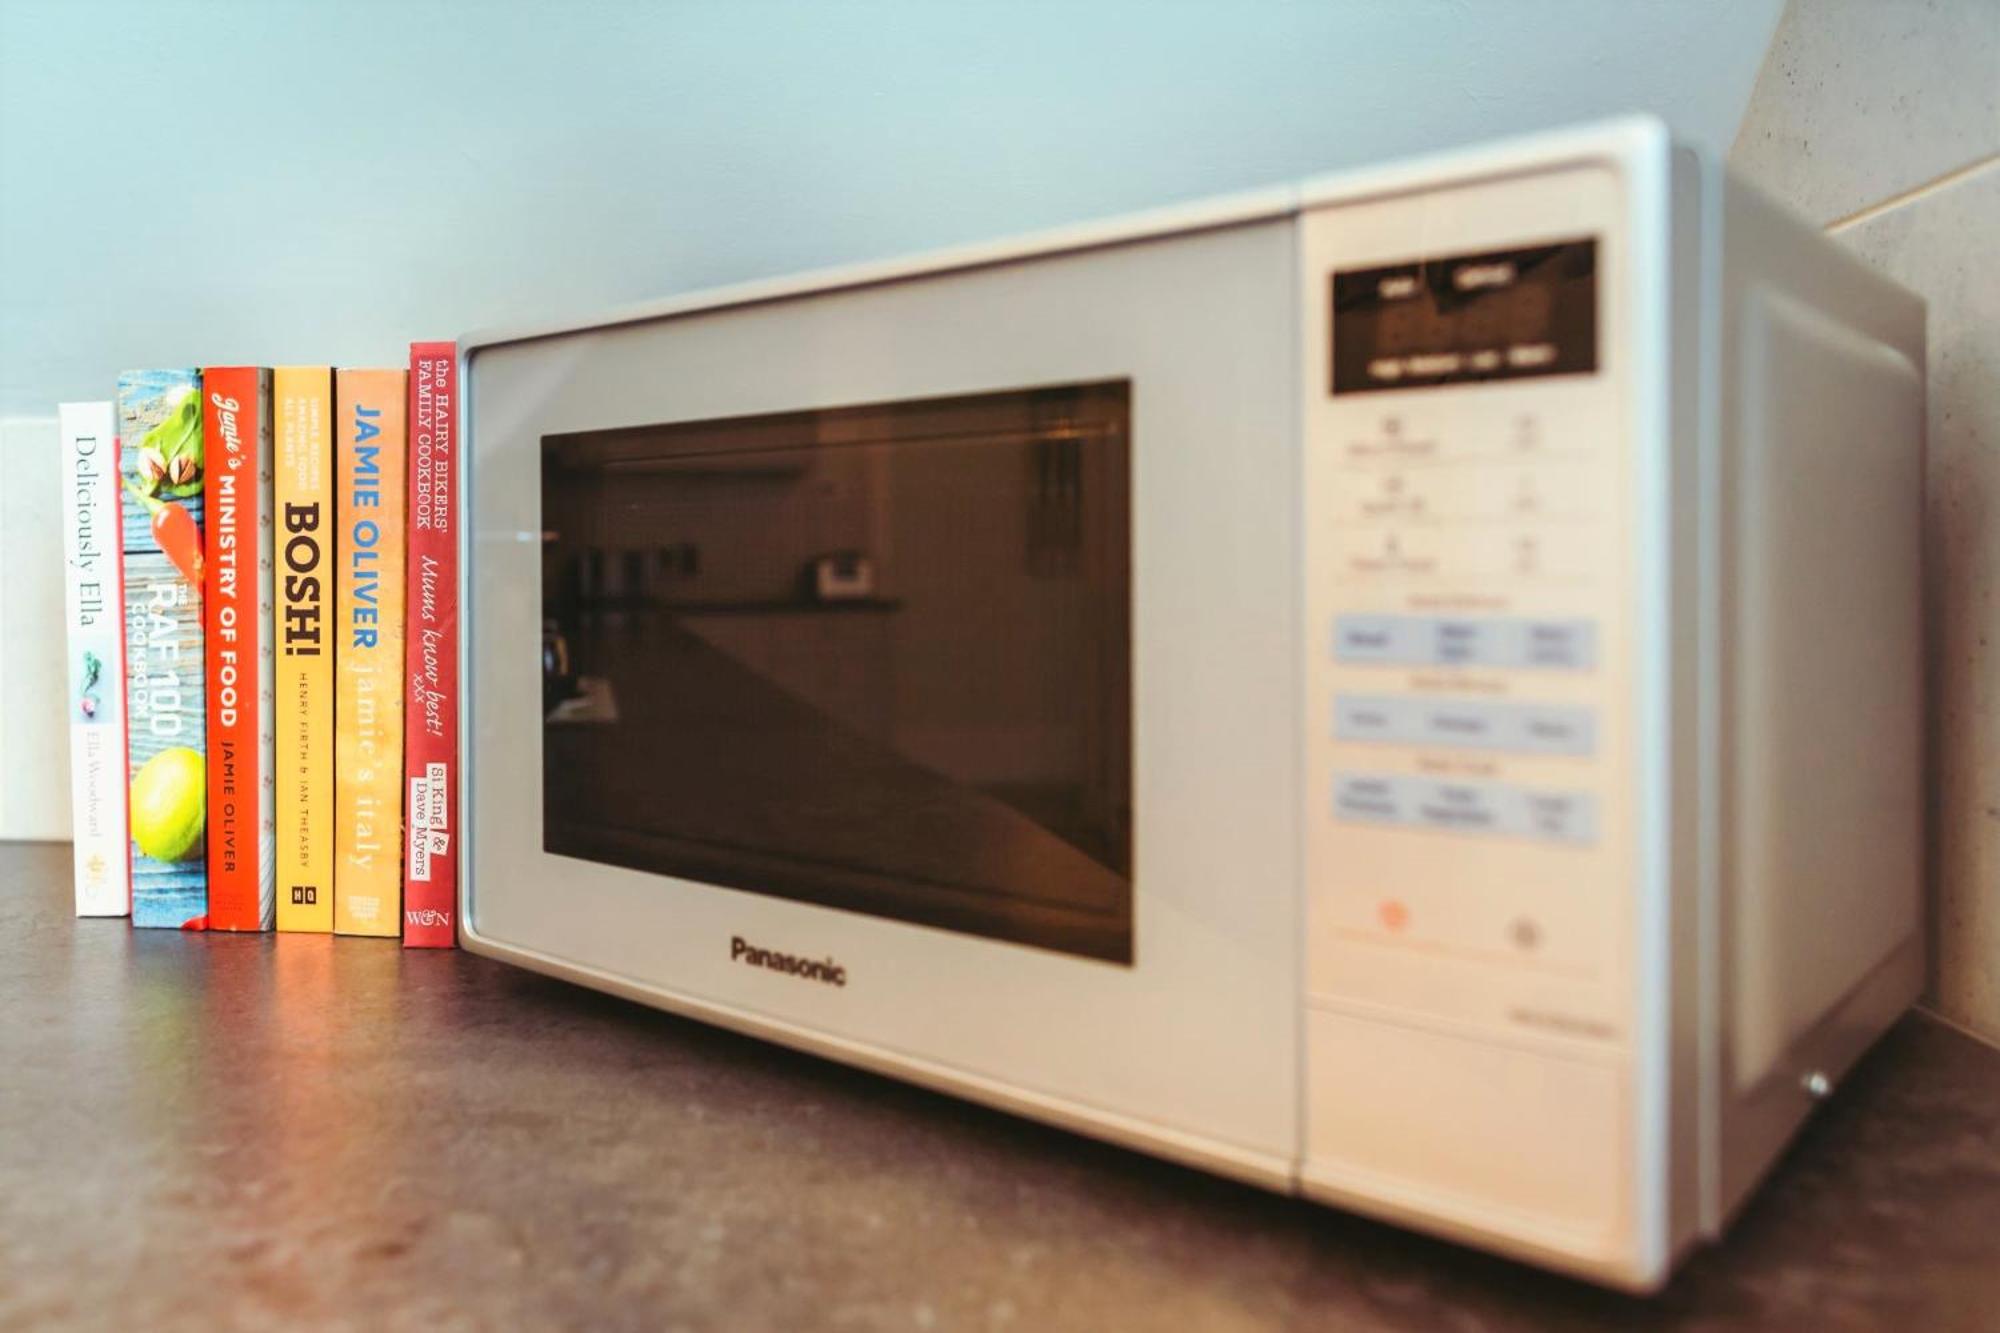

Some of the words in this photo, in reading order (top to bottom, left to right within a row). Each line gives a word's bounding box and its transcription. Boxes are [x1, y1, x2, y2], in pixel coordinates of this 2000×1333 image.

[418, 360, 432, 426] FAMILY
[436, 359, 448, 388] the
[211, 392, 246, 469] Jamie's
[436, 394, 449, 452] HAIRY
[353, 404, 381, 508] JAMIE
[417, 433, 431, 530] COOKBOOK
[69, 436, 101, 572] Deliciously
[434, 461, 448, 533] BIKERS'
[219, 475, 236, 599] MINISTRY
[80, 582, 103, 627] Ella
[285, 502, 321, 656] BOSH!
[353, 520, 380, 649] OLIVER
[421, 555, 440, 621] Mums
[147, 583, 179, 661] RAF
[219, 608, 236, 642] OF
[131, 602, 149, 717] COOKBOOK
[412, 672, 424, 703] xxx
[422, 628, 447, 689] know
[151, 671, 182, 735] 100
[220, 651, 237, 727] FOOD
[299, 672, 308, 716] HENRY
[425, 691, 447, 737] best!
[87, 731, 100, 758] Ella
[300, 722, 309, 760] FIRTH
[351, 662, 384, 782] jamie's
[221, 742, 235, 795] JAMIE
[300, 781, 309, 803] IAN
[431, 766, 443, 783] Si
[87, 761, 102, 838] Woodward
[416, 782, 428, 820] Dave
[429, 787, 444, 826] King
[223, 804, 236, 873] OLIVER
[300, 808, 310, 868] THEASBY
[349, 798, 382, 870] italy
[411, 826, 428, 876] Myers
[432, 836, 446, 852] &
[406, 910, 449, 926] W&N
[731, 936, 846, 987] Panasonic
